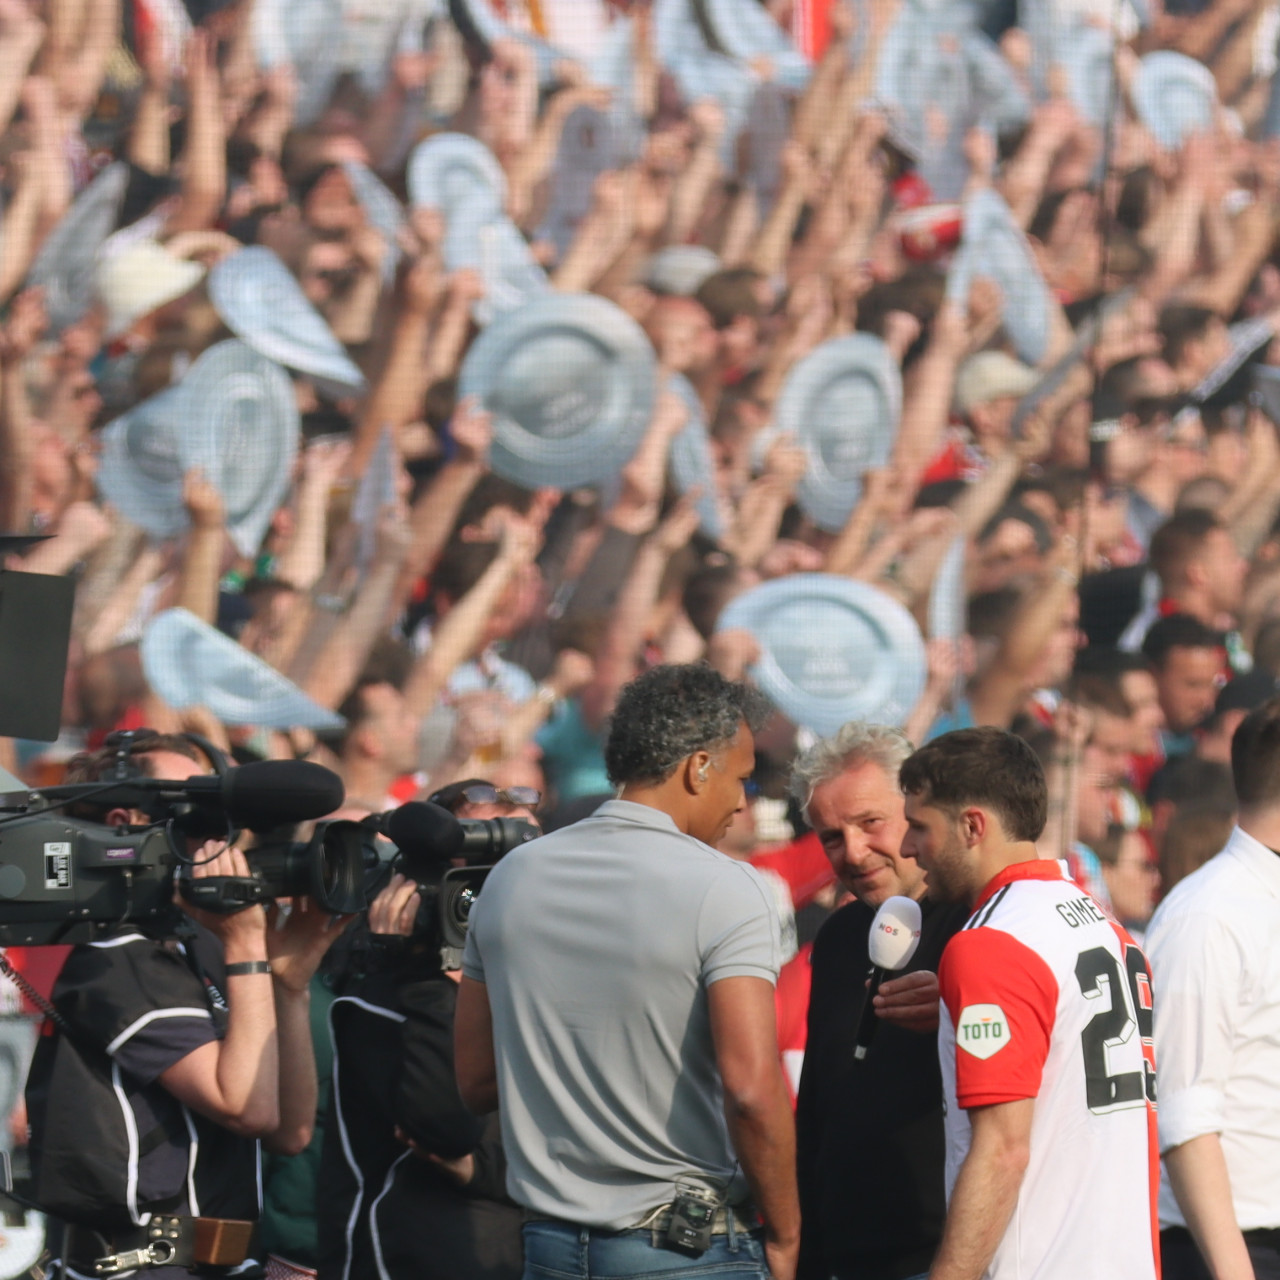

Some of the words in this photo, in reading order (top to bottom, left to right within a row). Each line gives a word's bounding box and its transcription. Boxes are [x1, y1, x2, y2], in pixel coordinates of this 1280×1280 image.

[1055, 897, 1106, 929] GIME
[879, 922, 899, 936] NOS
[961, 1021, 1002, 1041] TOTO
